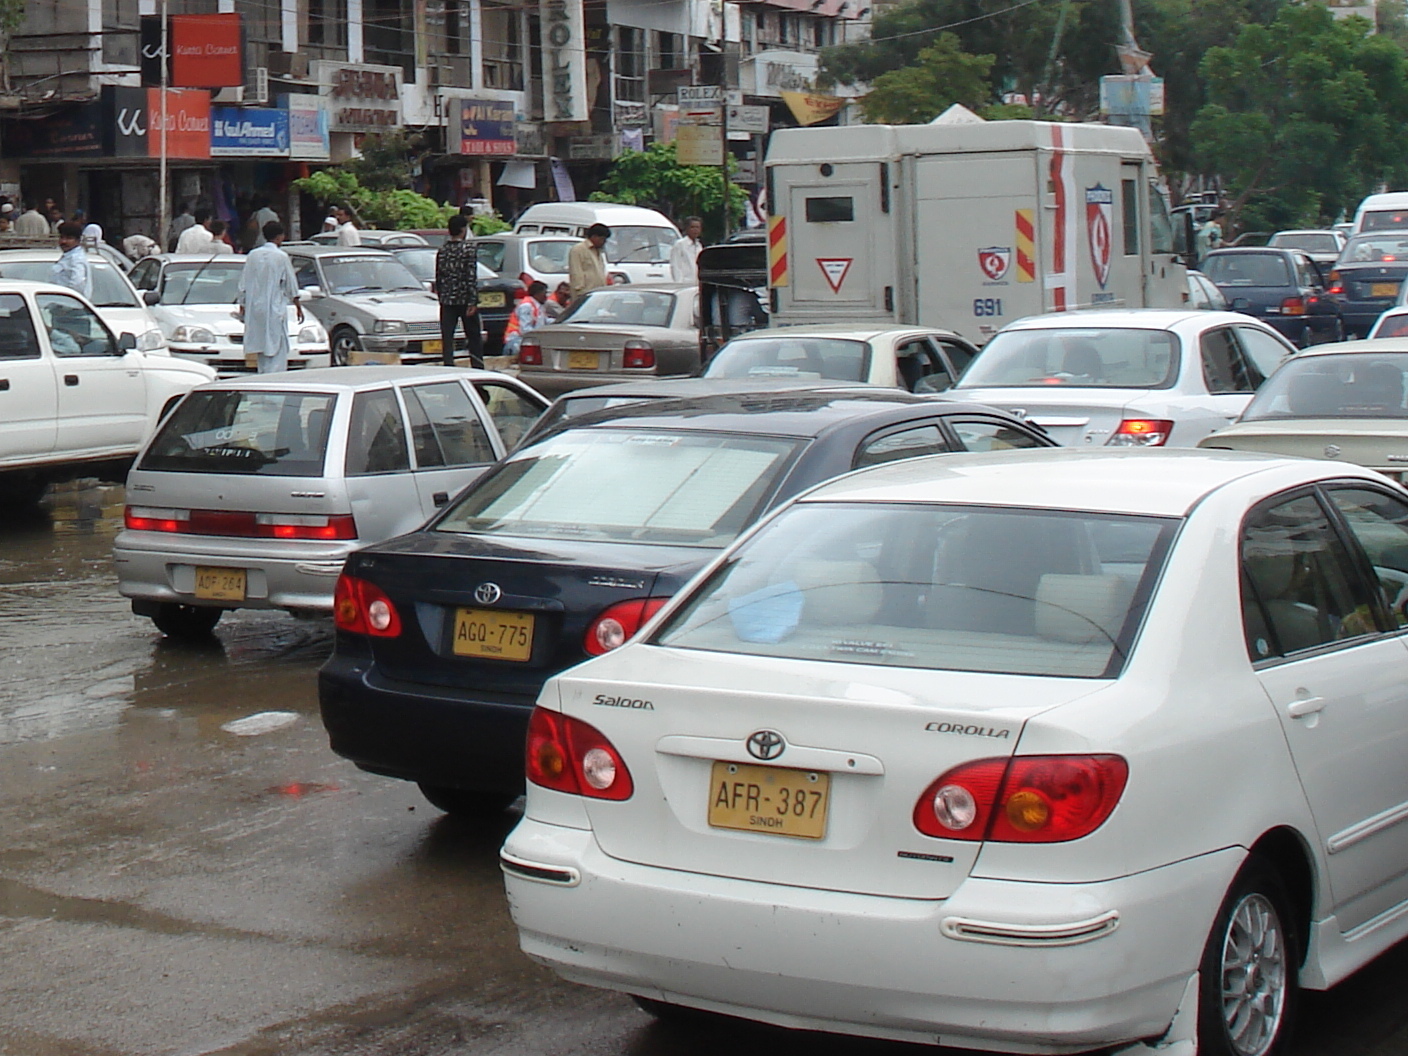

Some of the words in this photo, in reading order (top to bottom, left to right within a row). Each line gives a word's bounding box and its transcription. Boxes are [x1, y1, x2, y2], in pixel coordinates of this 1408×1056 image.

[680, 86, 720, 100] ROLEX
[973, 298, 1003, 316] 691
[592, 693, 656, 711] Saloon
[924, 721, 1011, 740] COROLLA
[715, 780, 823, 819] AFR-387
[748, 814, 784, 829] SINDH
